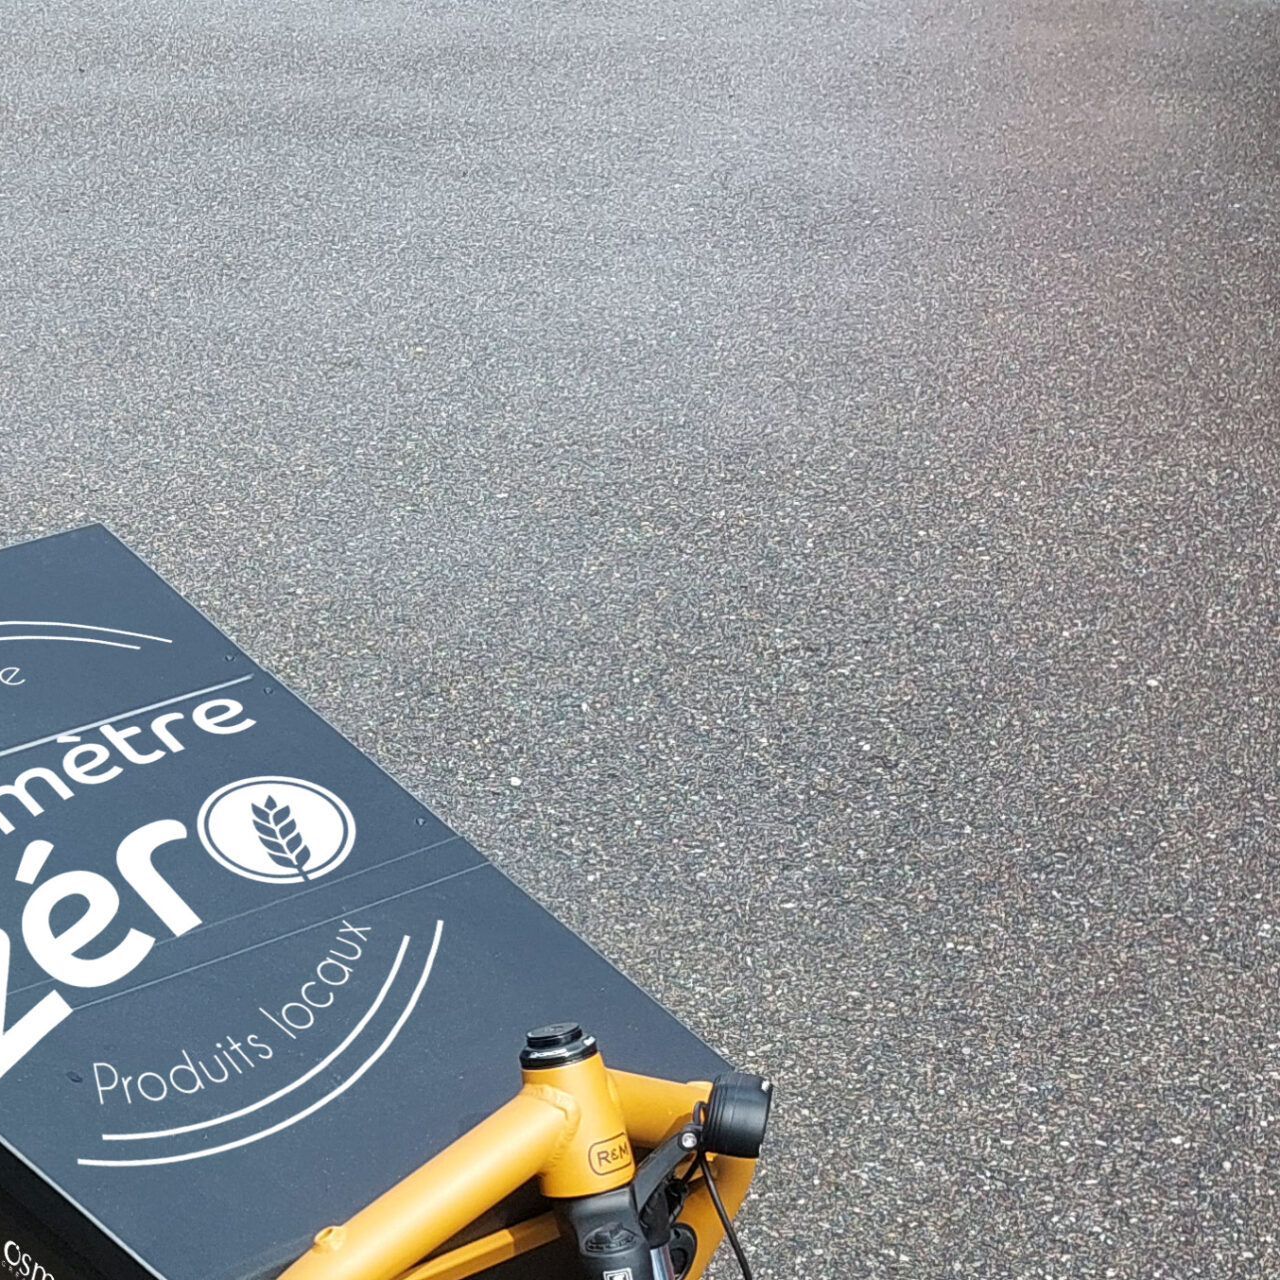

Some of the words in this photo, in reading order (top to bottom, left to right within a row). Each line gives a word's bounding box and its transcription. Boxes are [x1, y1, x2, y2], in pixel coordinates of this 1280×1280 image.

[92, 1033, 273, 1105] Produits
[258, 918, 372, 1041] locaux
[596, 1141, 630, 1168] R&M
